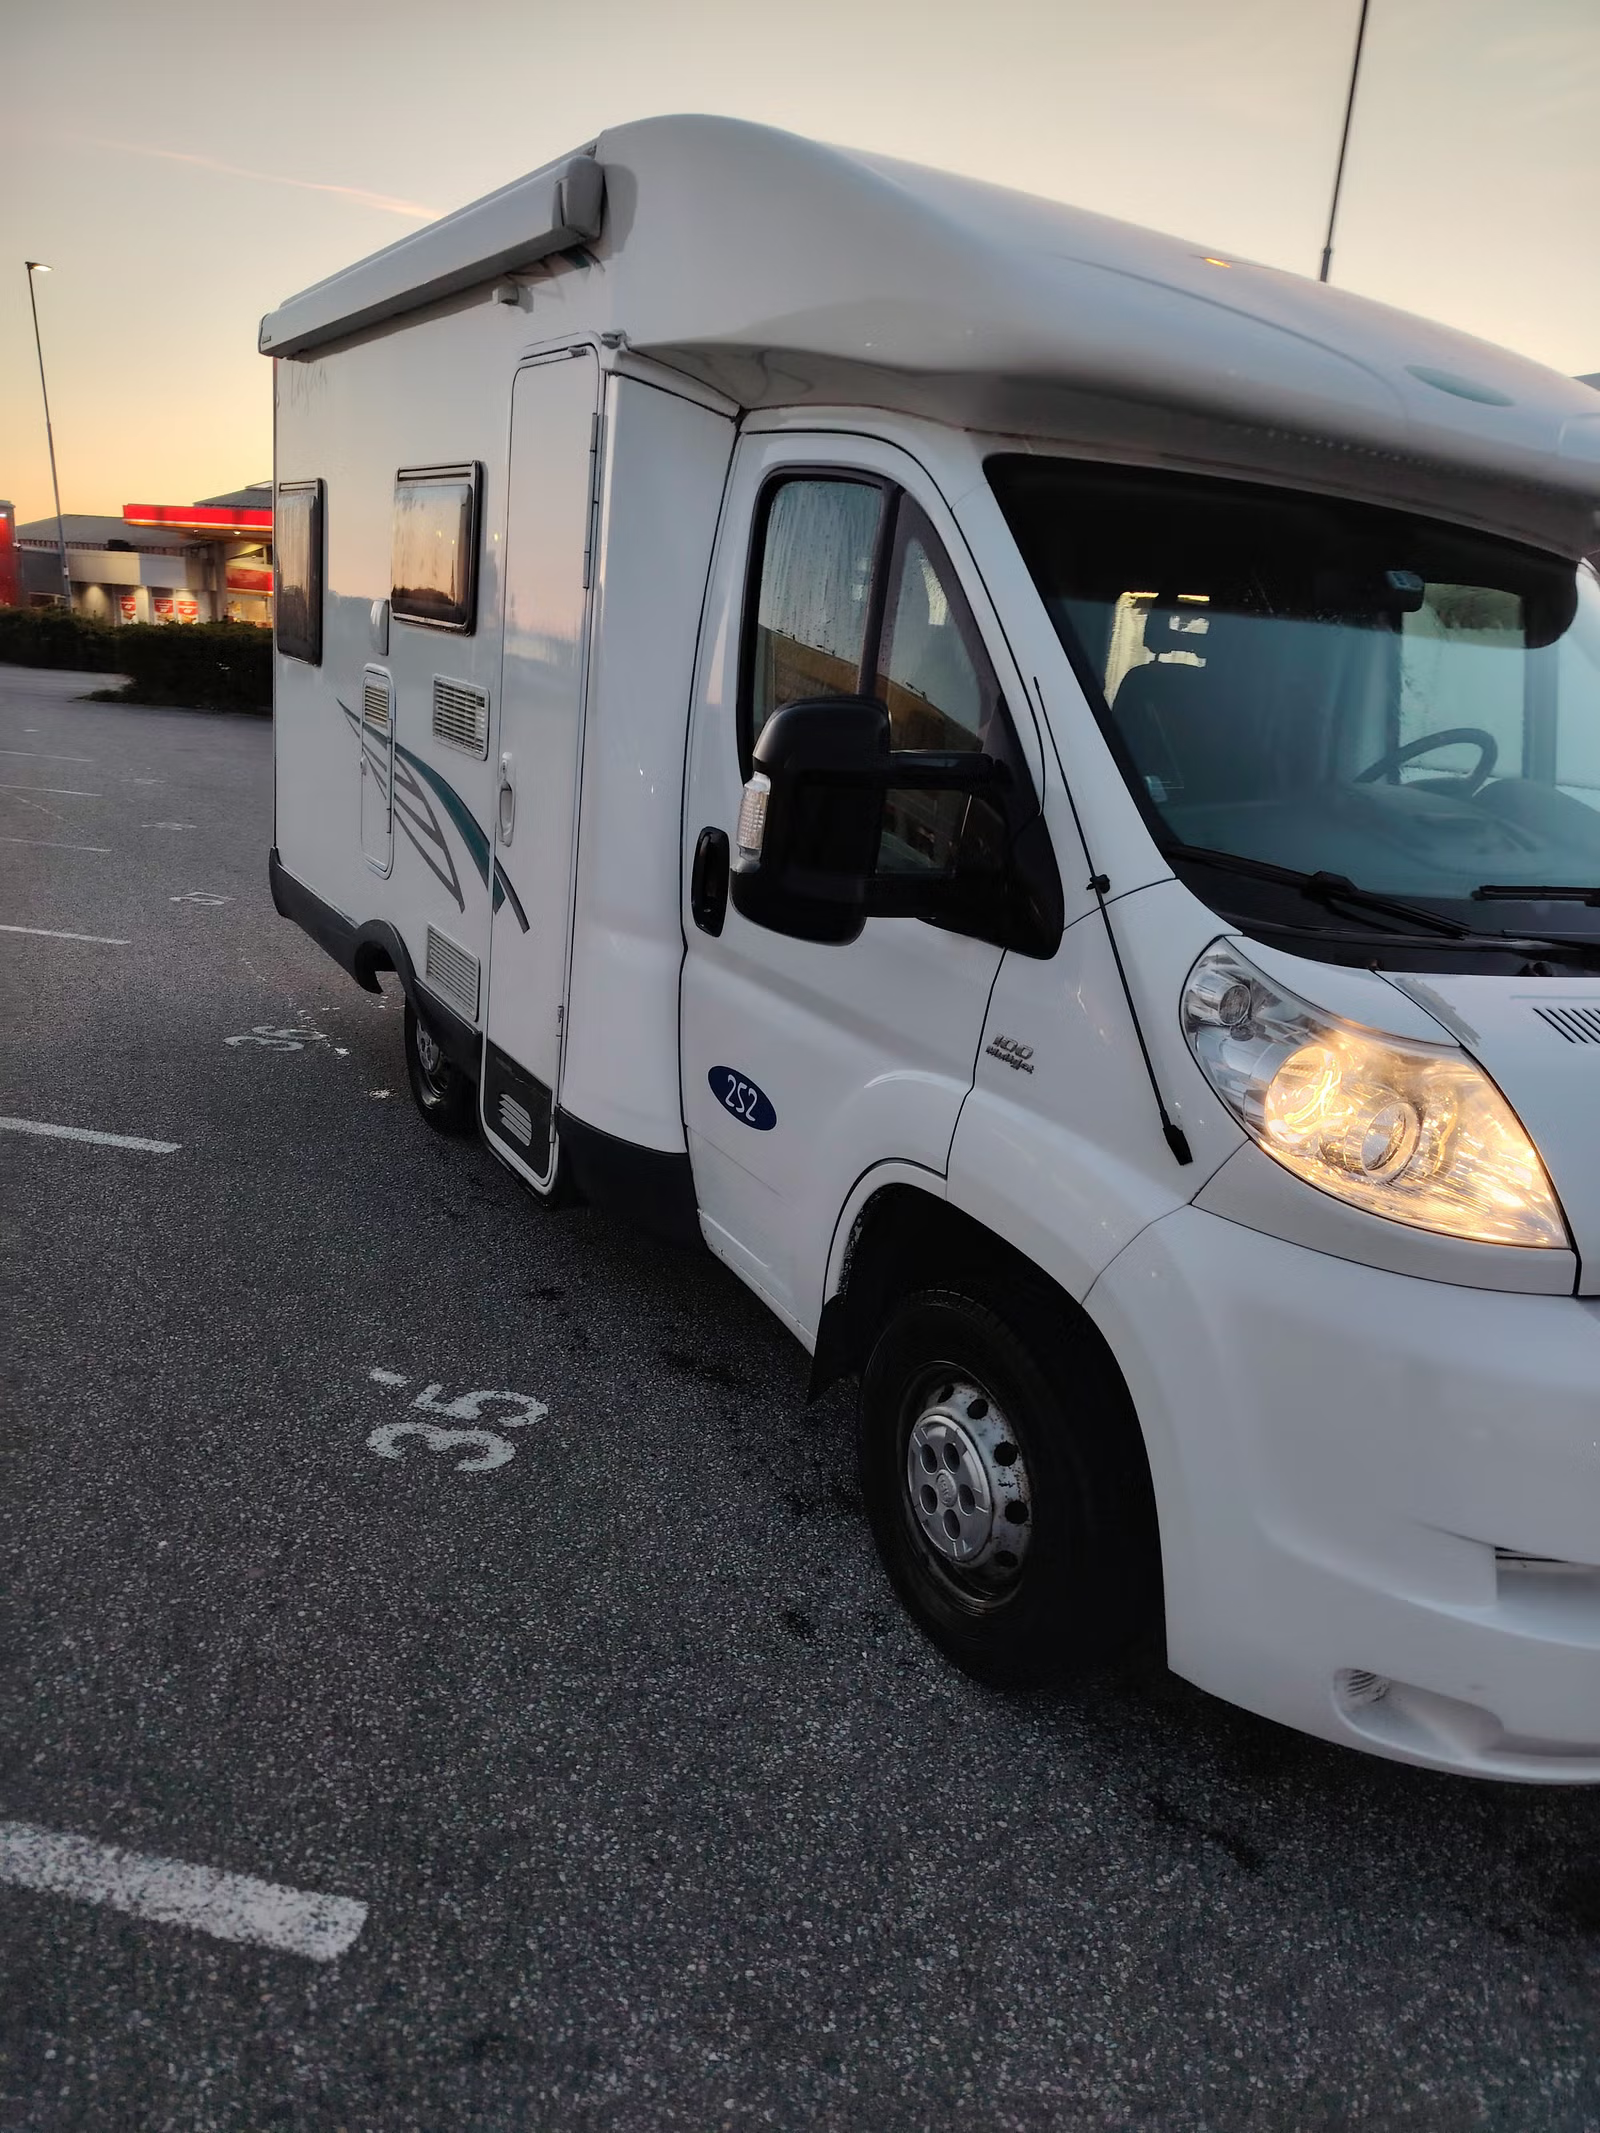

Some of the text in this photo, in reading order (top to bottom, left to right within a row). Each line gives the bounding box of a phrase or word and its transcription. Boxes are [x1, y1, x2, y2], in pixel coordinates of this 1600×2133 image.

[992, 1034, 1034, 1060] 100
[725, 1074, 758, 1122] 252
[366, 1367, 549, 1472] 35
